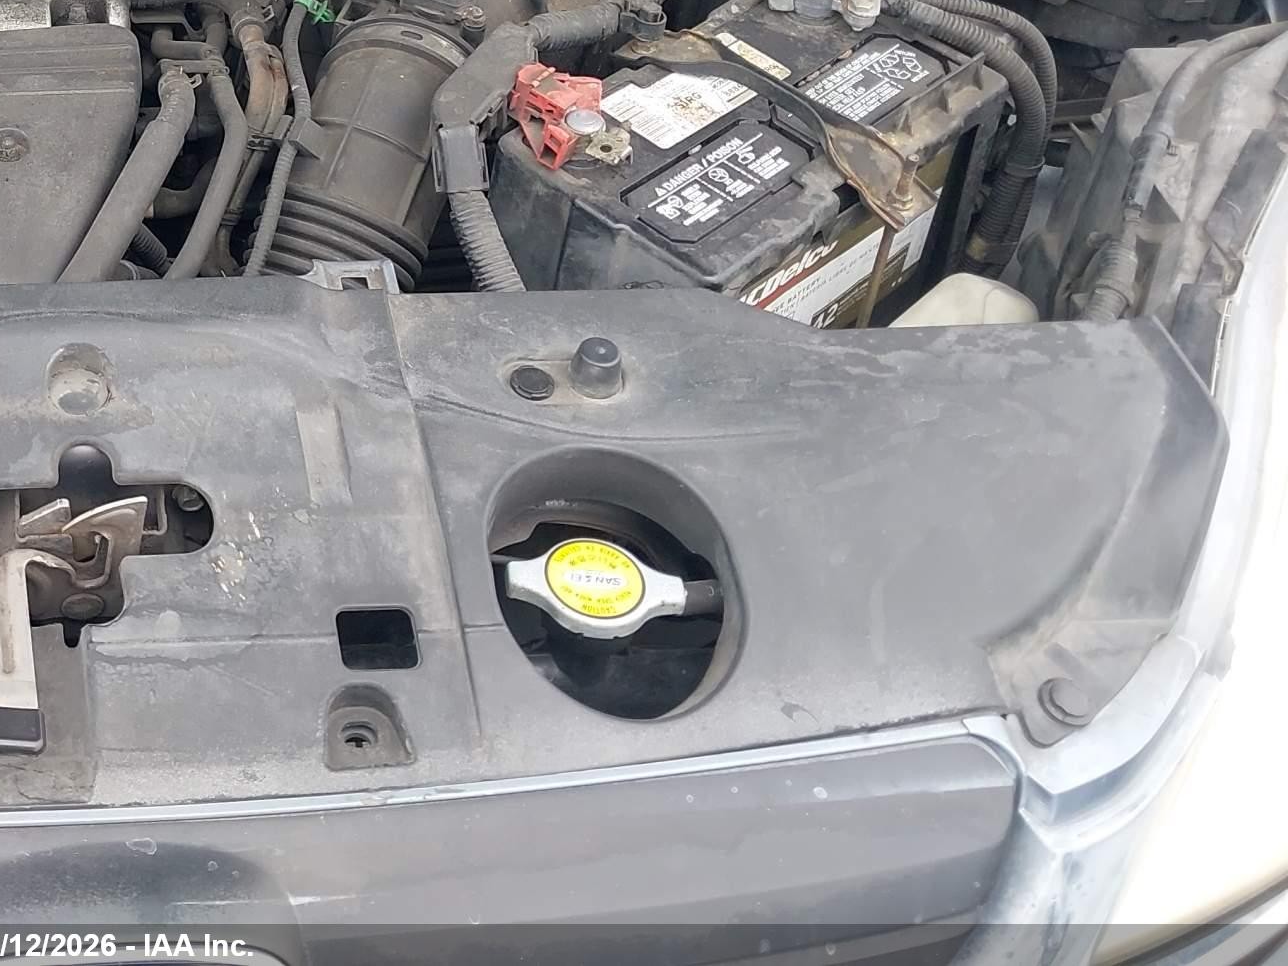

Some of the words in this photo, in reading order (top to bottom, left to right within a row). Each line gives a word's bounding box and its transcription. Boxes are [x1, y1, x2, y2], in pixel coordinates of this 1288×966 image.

[661, 163, 704, 192] DANGER
[706, 137, 744, 163] POISON
[739, 239, 839, 307] CDelco
